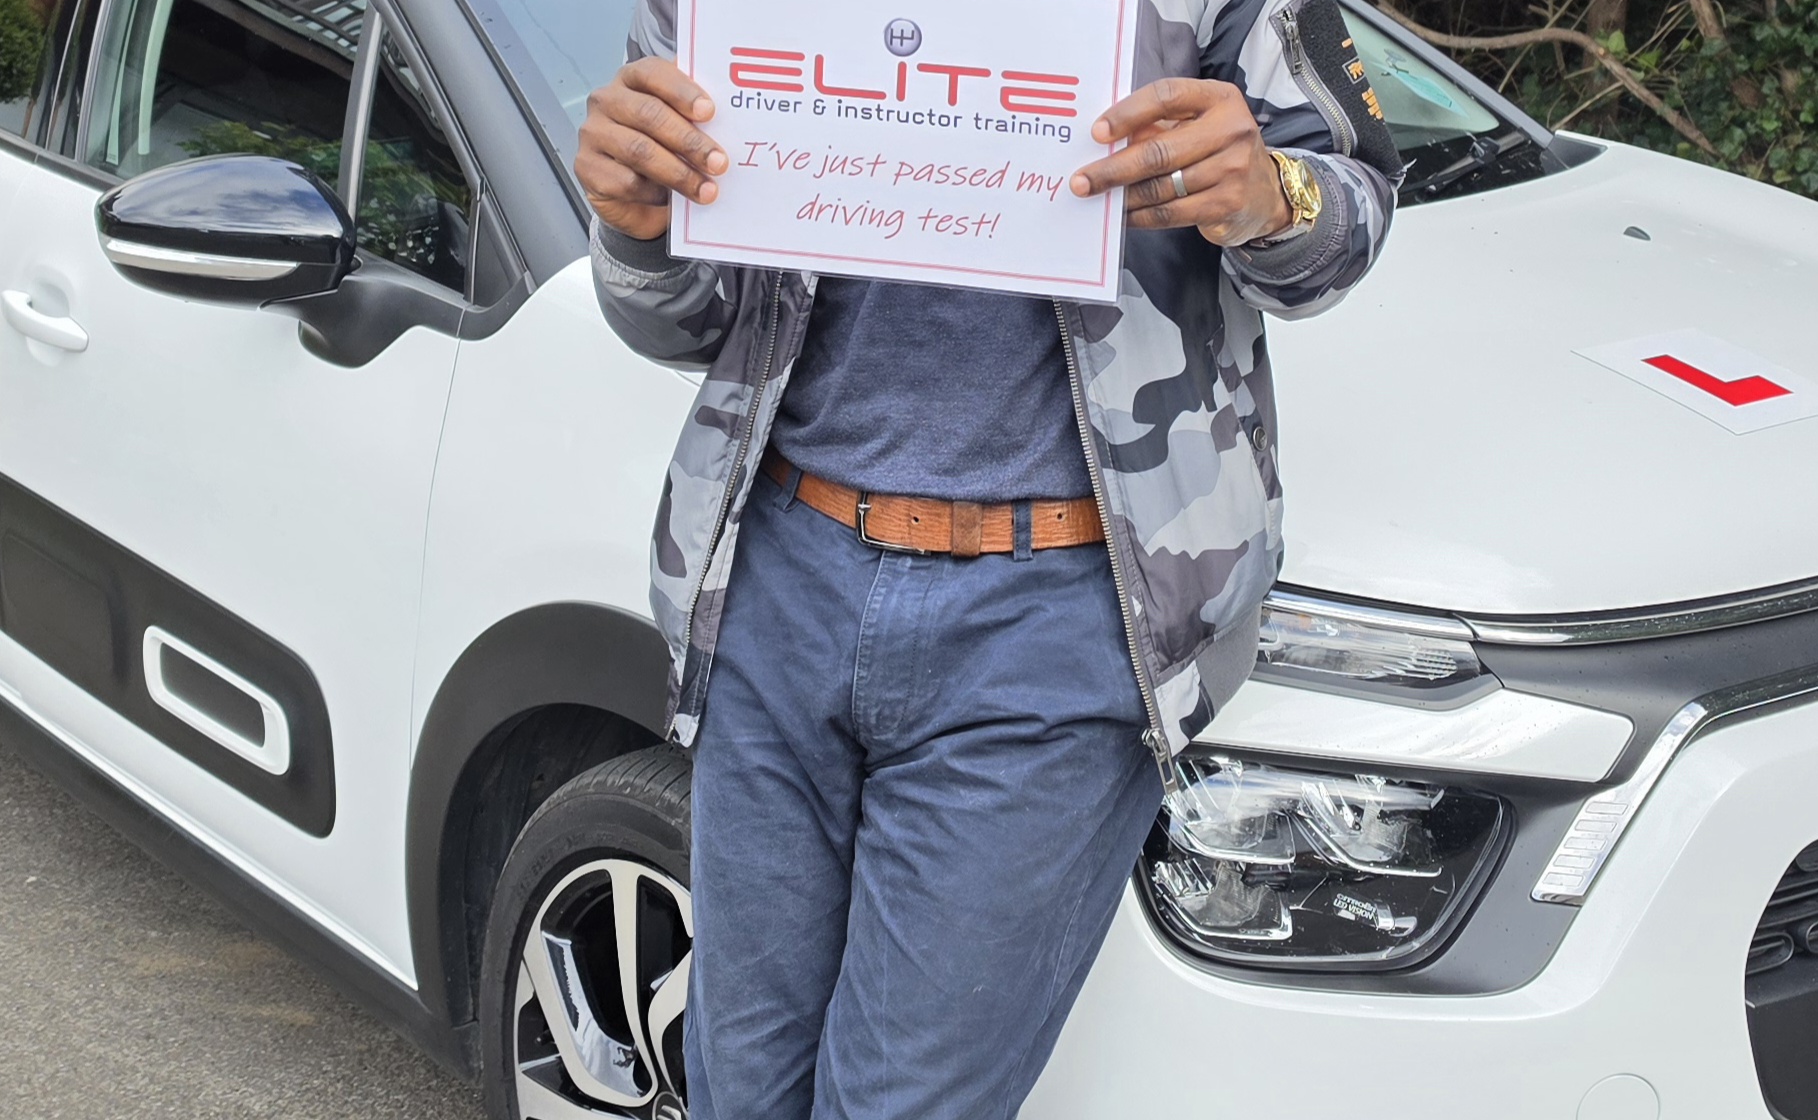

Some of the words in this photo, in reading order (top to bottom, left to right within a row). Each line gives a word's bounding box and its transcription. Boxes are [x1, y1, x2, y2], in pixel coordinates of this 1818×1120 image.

[729, 46, 1080, 118] ELITE
[730, 90, 802, 113] driver
[812, 98, 827, 116] &
[837, 99, 963, 128] instructor
[973, 112, 1071, 143] training
[738, 141, 811, 170] I've
[813, 145, 887, 179] just
[893, 160, 1011, 188] passed
[1015, 171, 1063, 202] my
[796, 193, 905, 239] driving
[918, 208, 1001, 239] test!
